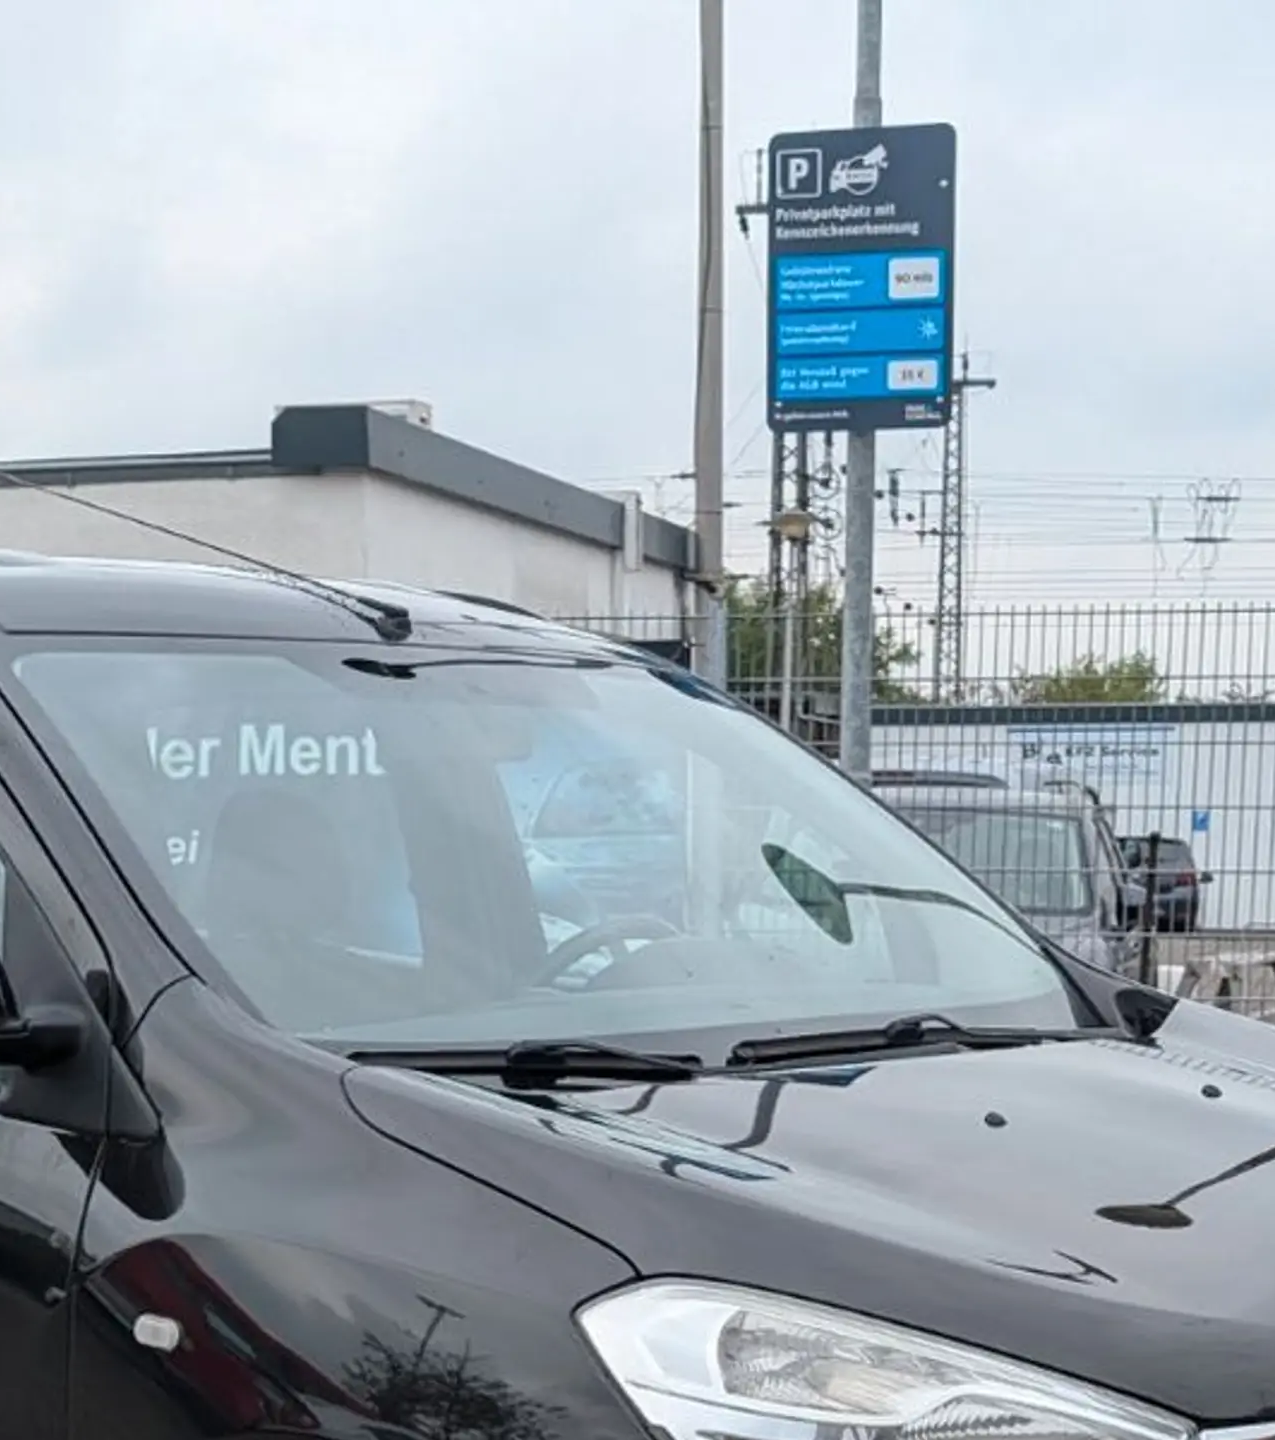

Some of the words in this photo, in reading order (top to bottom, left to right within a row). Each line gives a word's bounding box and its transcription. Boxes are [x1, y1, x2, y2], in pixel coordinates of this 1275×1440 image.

[789, 158, 809, 189] P
[776, 204, 871, 222] Privatparkplatz
[874, 203, 895, 217] mit
[776, 221, 920, 240] Kennzeichenerkennung
[238, 723, 388, 777] Ment
